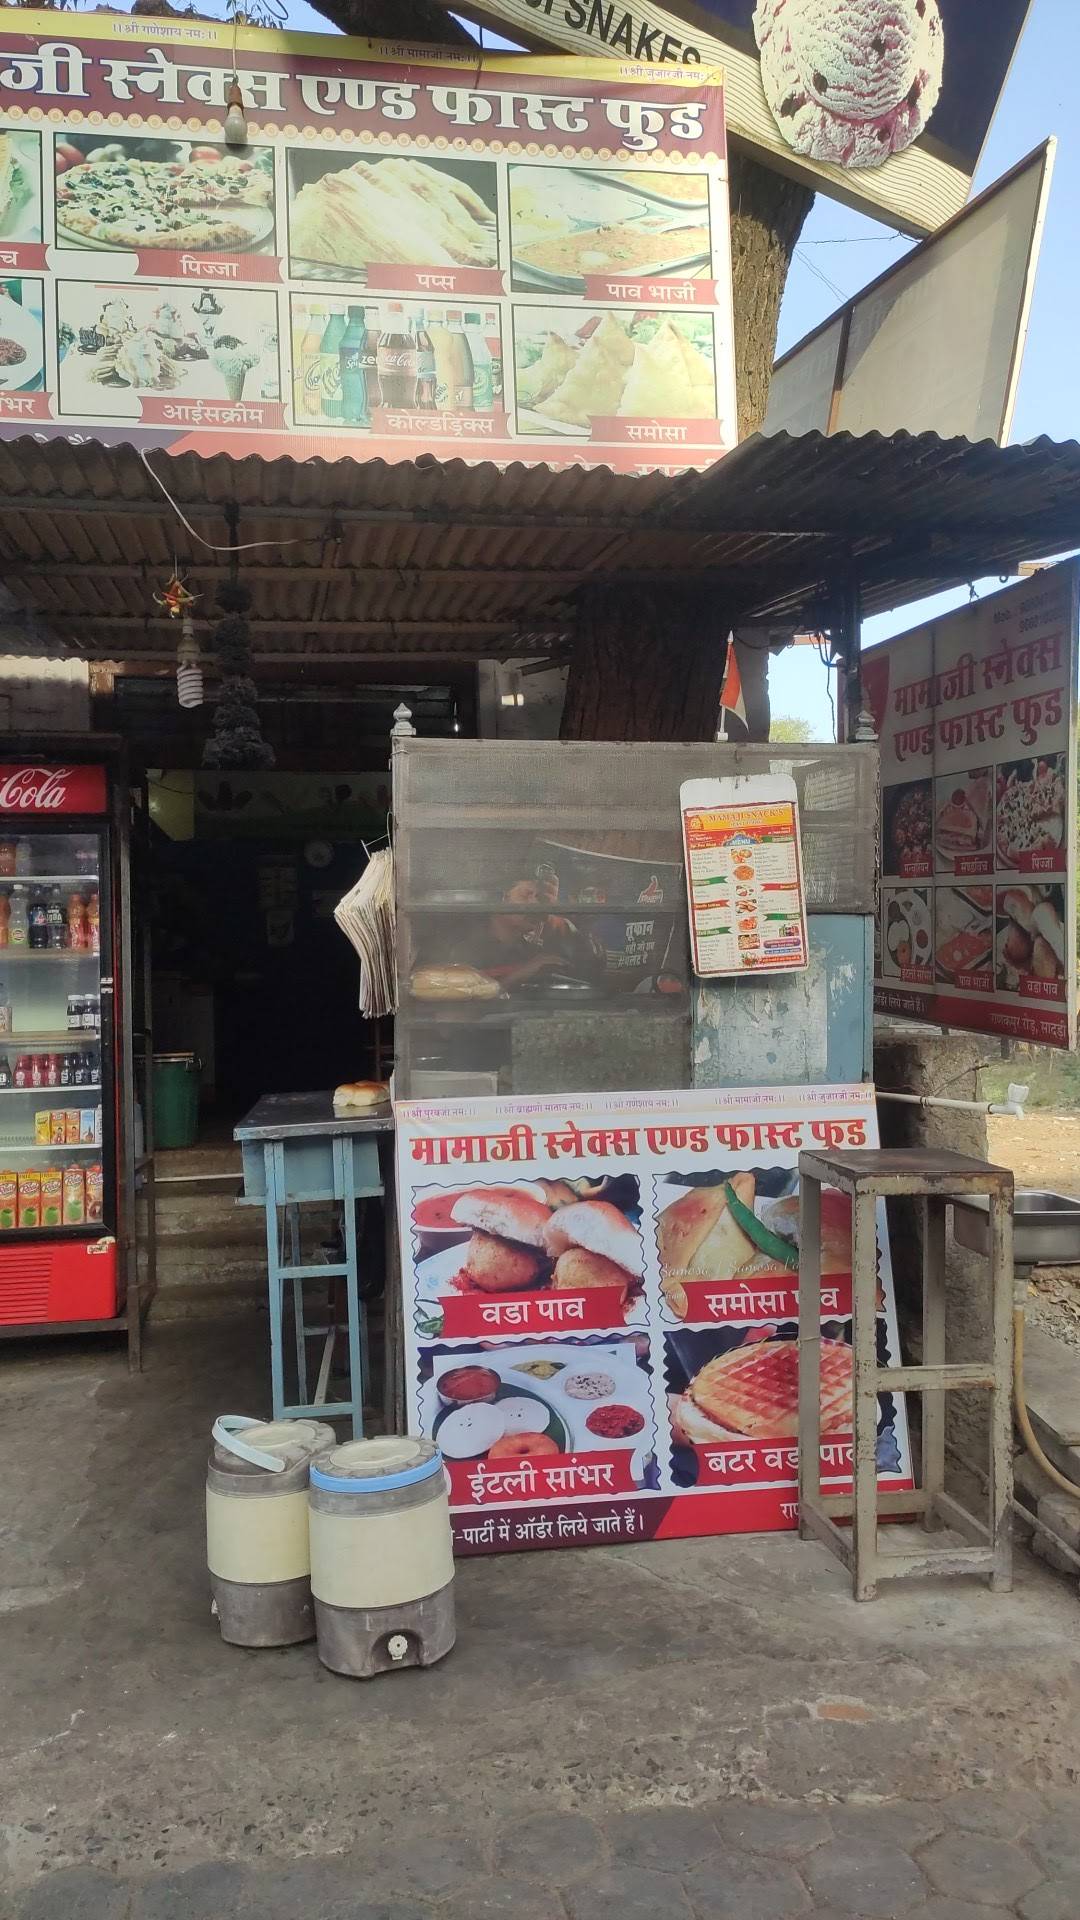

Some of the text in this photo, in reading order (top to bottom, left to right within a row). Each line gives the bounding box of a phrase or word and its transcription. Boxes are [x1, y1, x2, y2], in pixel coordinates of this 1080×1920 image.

[99, 48, 290, 113] स्नेक्स
[296, 74, 421, 120] एण्ड
[426, 80, 595, 133] फास्ट
[598, 94, 708, 150] फुड
[179, 253, 240, 278] पिज्जा
[606, 280, 697, 303] पाव भाजी
[162, 399, 265, 426] आईसक्रीम
[625, 420, 688, 442] समोसा
[894, 632, 1063, 717] मामाजी स्नेक्स
[893, 687, 1065, 762] एण्ड फास्ट फुड
[1026, 980, 1058, 996] वडा पाव
[408, 1123, 538, 1166] मामाजी
[541, 1120, 641, 1160] स्नेक्स
[643, 1124, 710, 1155] एण्ड
[713, 1121, 804, 1152] फास्ट
[479, 1296, 586, 1327] वडा पाव
[703, 1282, 788, 1319] समोसा
[703, 1449, 757, 1475] बटर
[467, 1459, 617, 1506] ईटली सांभर
[498, 1517, 511, 1541] में
[514, 1514, 553, 1541] ऑर्डर
[556, 1511, 588, 1538] लिये
[591, 1508, 621, 1535] जाते
